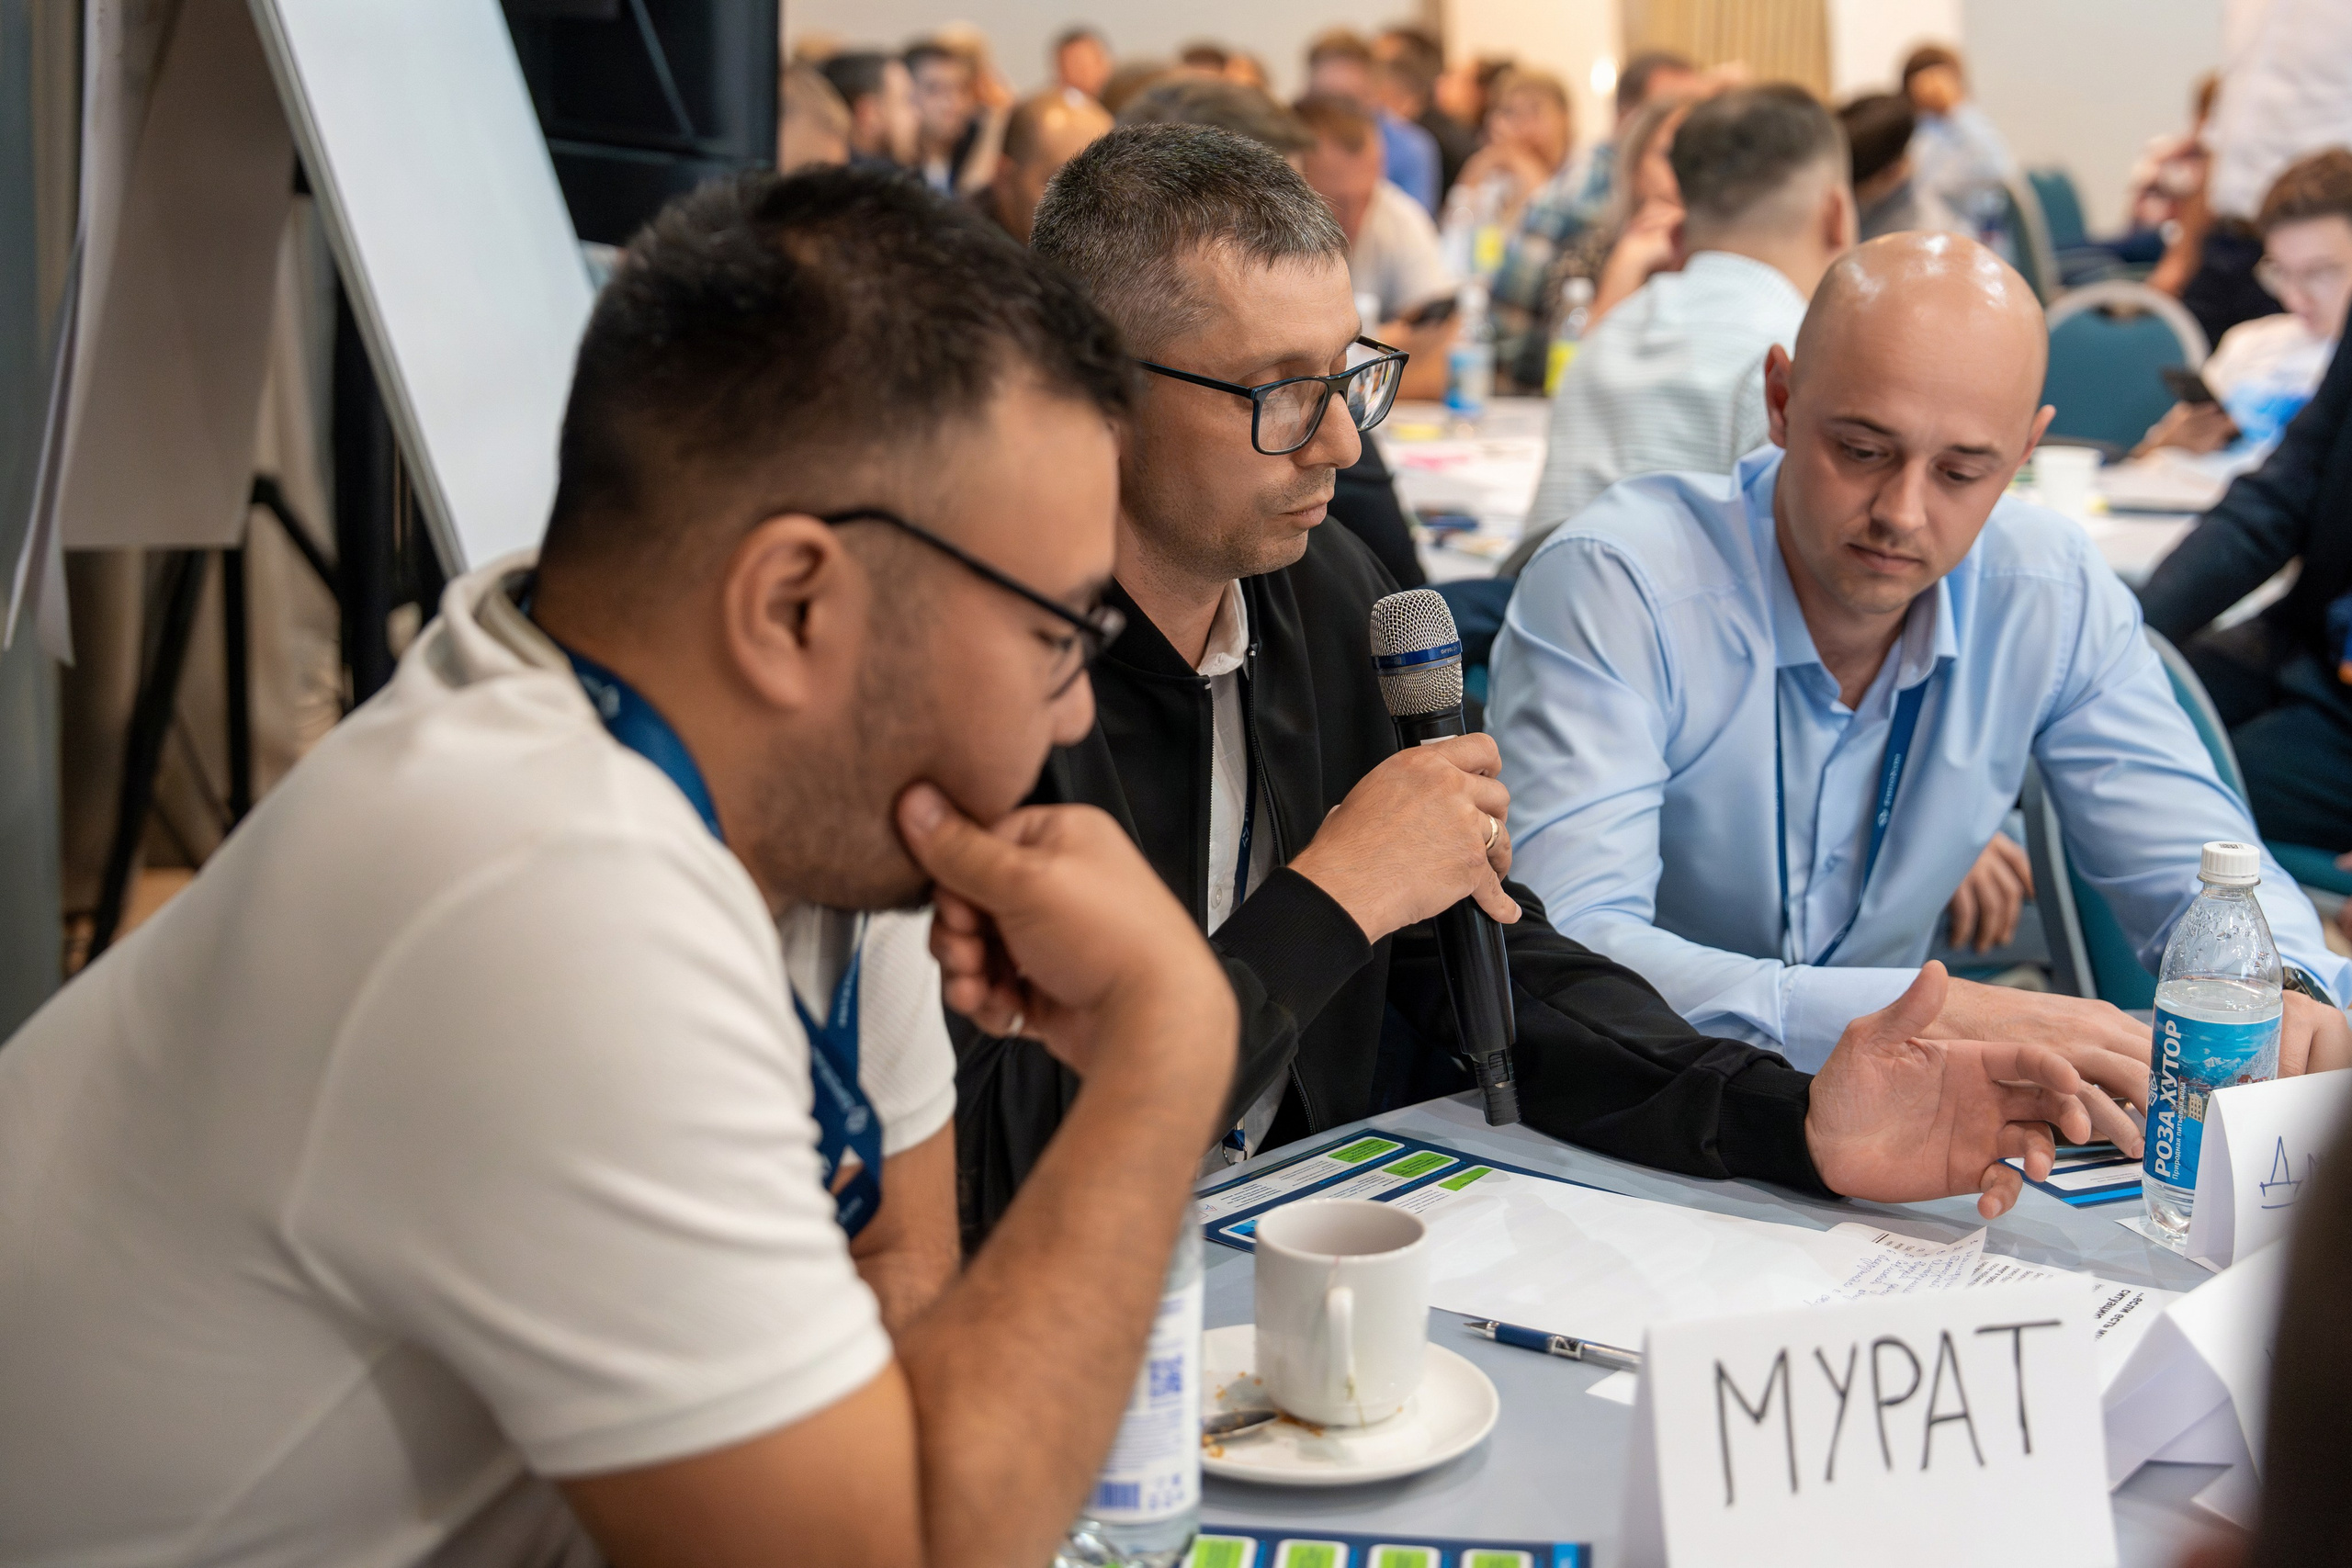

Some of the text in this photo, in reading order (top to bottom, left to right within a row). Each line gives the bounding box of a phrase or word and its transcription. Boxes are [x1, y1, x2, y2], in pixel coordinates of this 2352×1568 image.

[2154, 1020, 2182, 1178] РОЗА ХУТОР
[2171, 1137, 2182, 1180] Природная
[2177, 1100, 2186, 1137] питьевая
[2102, 1314, 2124, 1328] есть
[1713, 1318, 2063, 1507] МУРАТ
